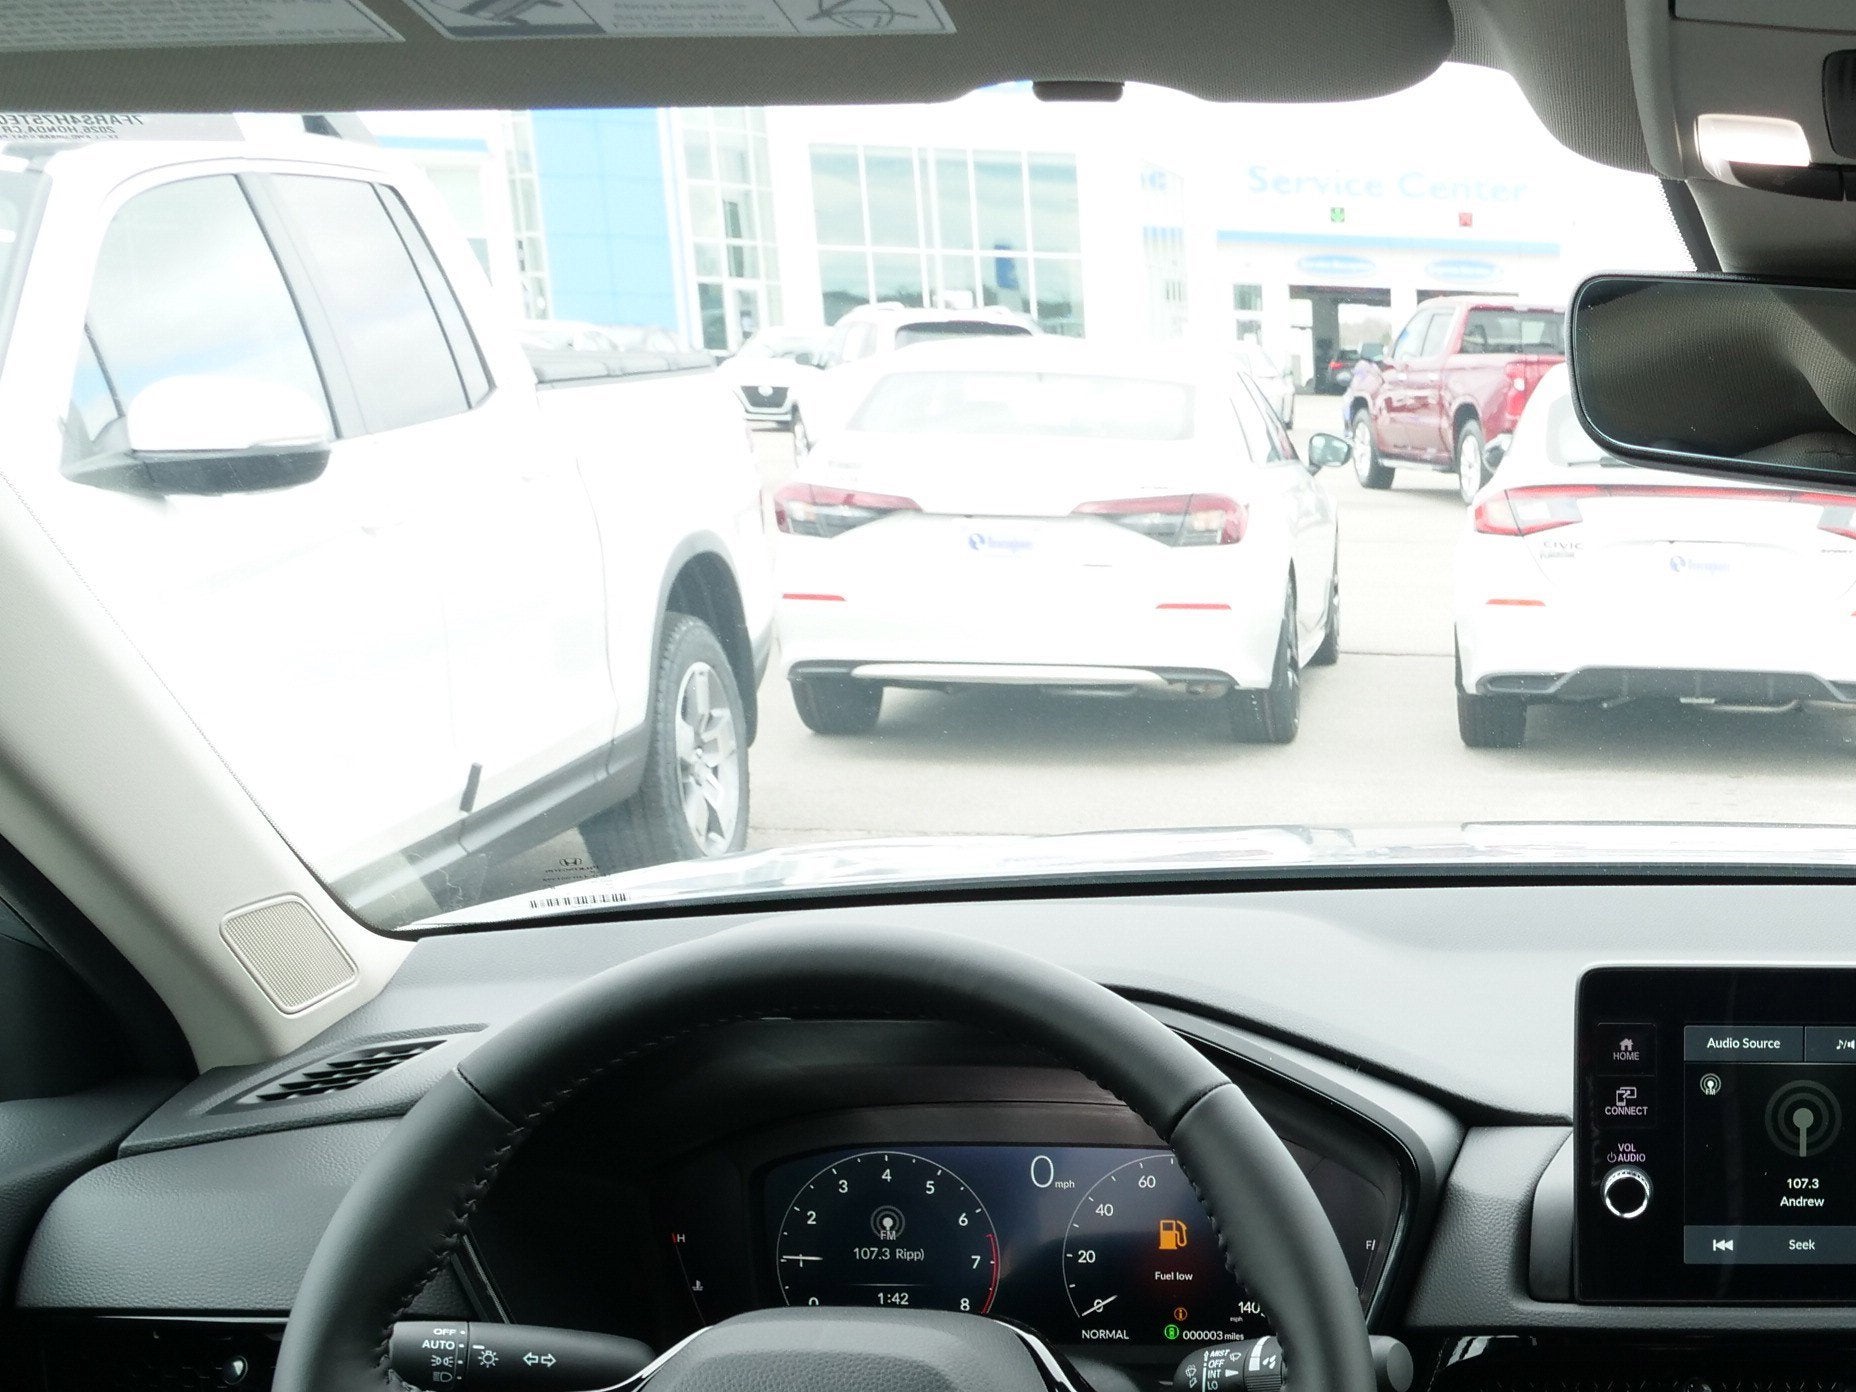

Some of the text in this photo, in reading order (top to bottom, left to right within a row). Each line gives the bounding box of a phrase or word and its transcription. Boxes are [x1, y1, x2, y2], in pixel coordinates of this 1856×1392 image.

[1247, 164, 1528, 201] Service Center
[1543, 541, 1584, 550] CIVIC
[1706, 1038, 1781, 1049] Audio Source
[1613, 1051, 1640, 1061] HOME
[1605, 1106, 1648, 1116] CONNECT
[1617, 1143, 1637, 1152] VOL
[1617, 1153, 1646, 1162] AUDIO
[881, 1168, 892, 1182] 4
[1030, 1155, 1076, 1191] 0 mph
[838, 1180, 849, 1193] 3
[925, 1180, 936, 1194] 5
[1138, 1175, 1156, 1188] 60
[1786, 1178, 1820, 1189] 107.3
[1780, 1196, 1825, 1207] Andrew
[1095, 1203, 1114, 1217] 40
[806, 1210, 817, 1224] 2
[958, 1212, 969, 1226] 6
[677, 1233, 686, 1242] H
[880, 1231, 897, 1241] FM
[1788, 1239, 1816, 1251] Seek
[853, 1247, 925, 1261] 107.3 Ripp)
[1078, 1250, 1096, 1264] 20
[971, 1255, 981, 1269] 7
[1154, 1271, 1194, 1281] Fuel low
[877, 1292, 910, 1305] 1:42
[960, 1297, 971, 1311] 8
[1238, 1300, 1261, 1314] 140
[433, 1328, 457, 1336] OFF
[1082, 1329, 1130, 1341] NORMAL
[1182, 1330, 1245, 1341] 000003 miles
[422, 1340, 456, 1350] AUTO
[1209, 1349, 1230, 1358] MIST
[1208, 1359, 1225, 1369] OFF
[1207, 1369, 1222, 1379] INT
[1207, 1380, 1218, 1390] LO
